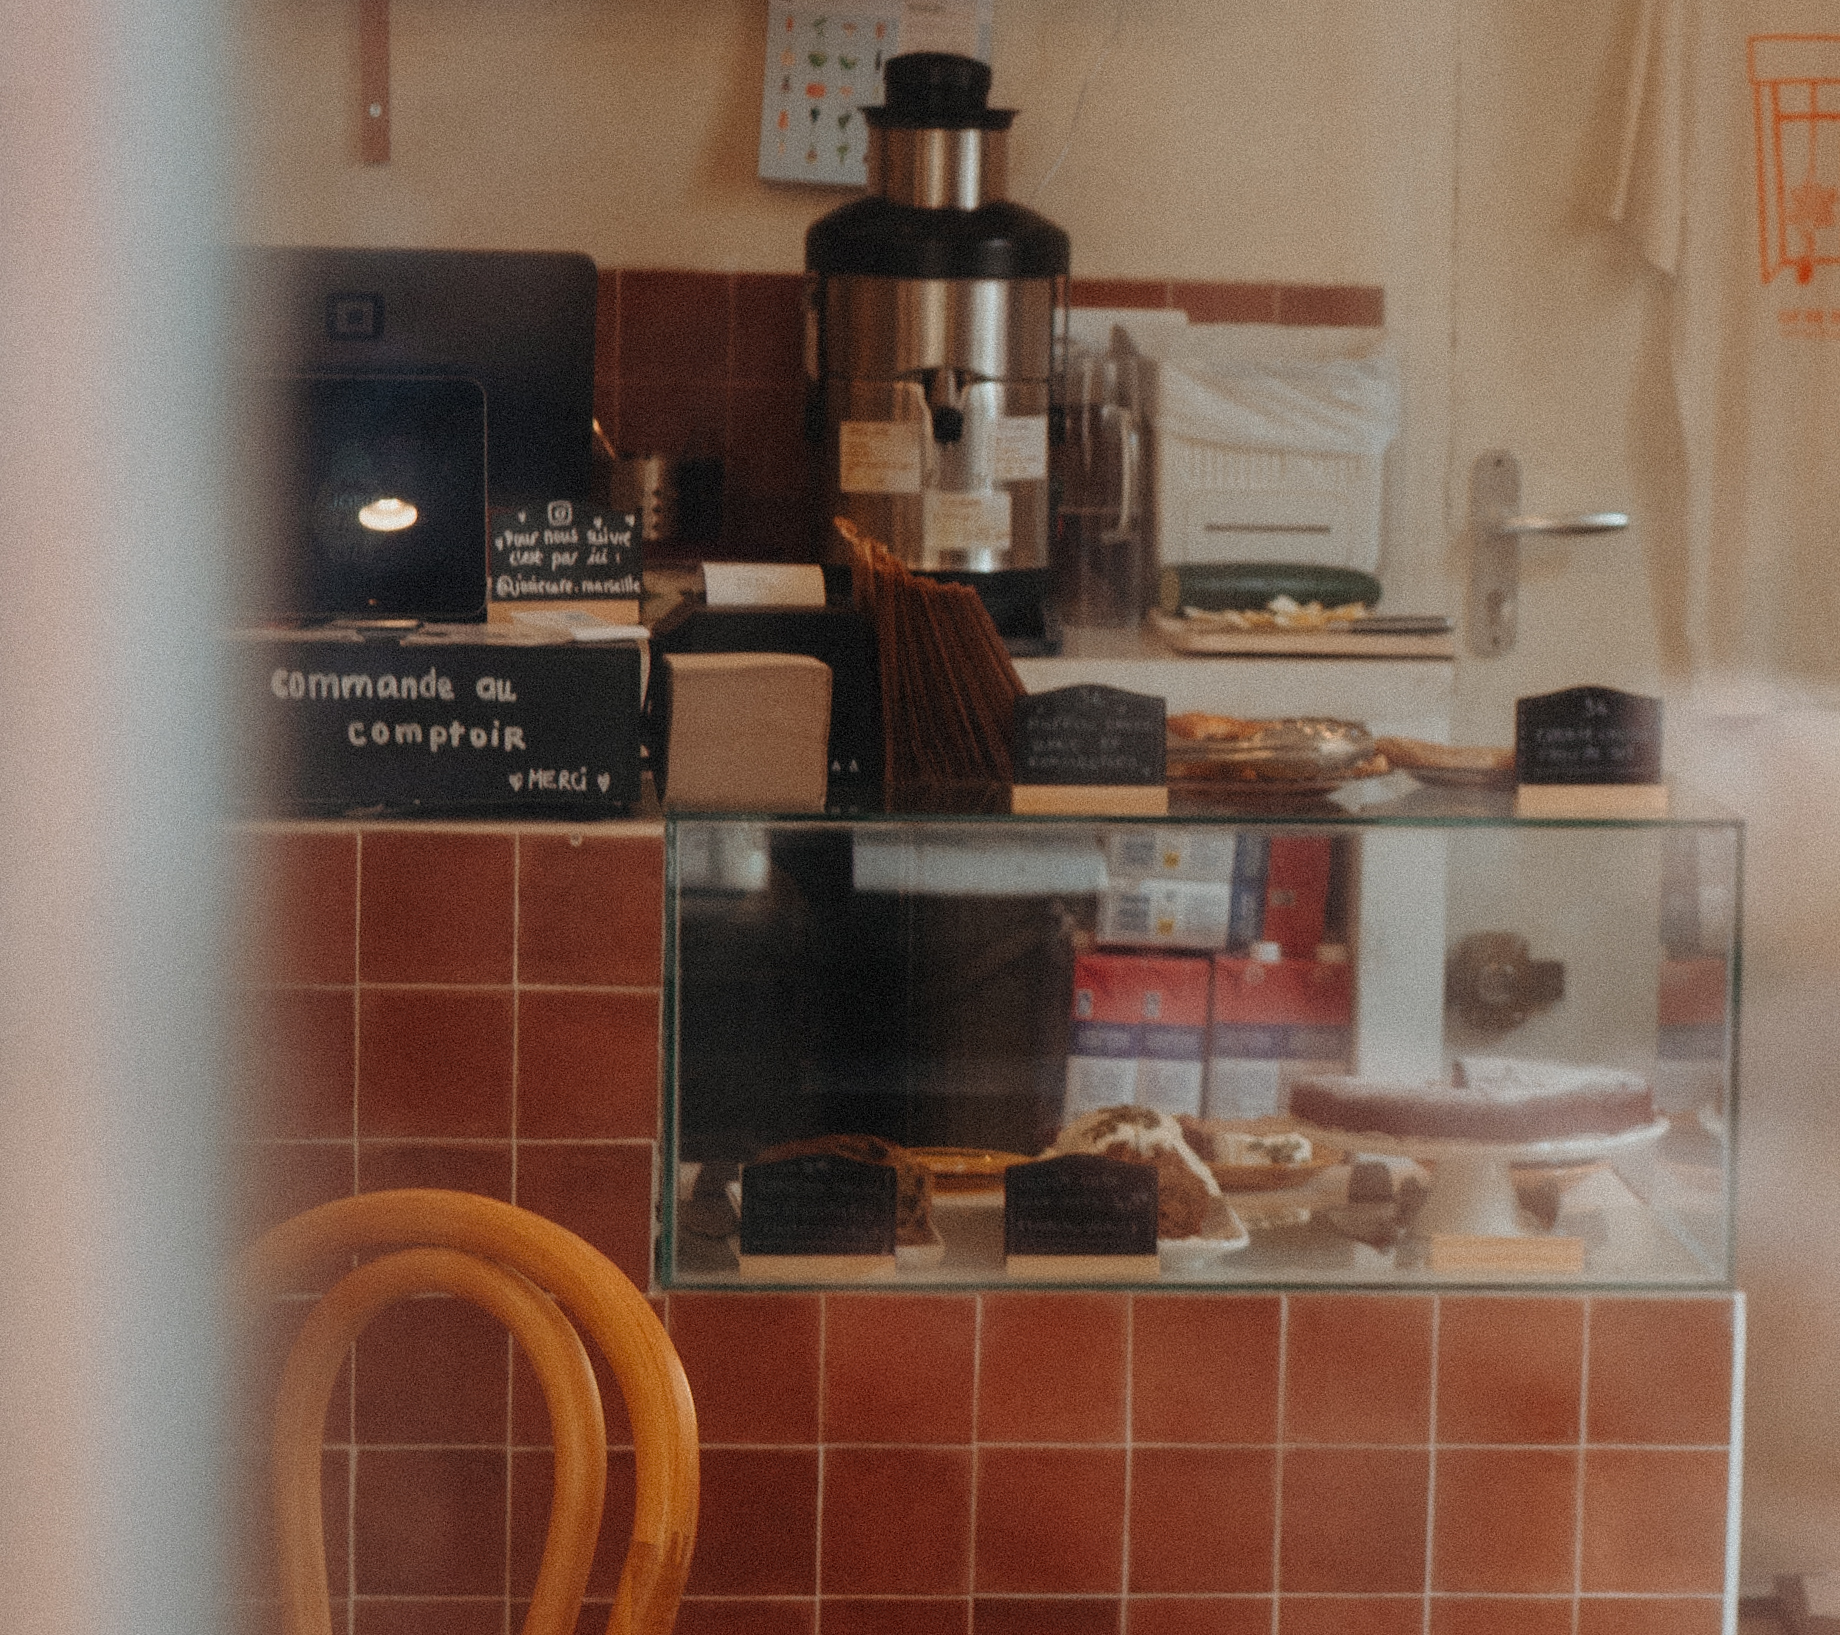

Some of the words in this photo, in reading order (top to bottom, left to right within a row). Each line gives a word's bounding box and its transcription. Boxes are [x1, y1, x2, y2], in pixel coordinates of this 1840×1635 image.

[543, 527, 579, 545] nous
[550, 550, 579, 572] par
[474, 676, 518, 702] au
